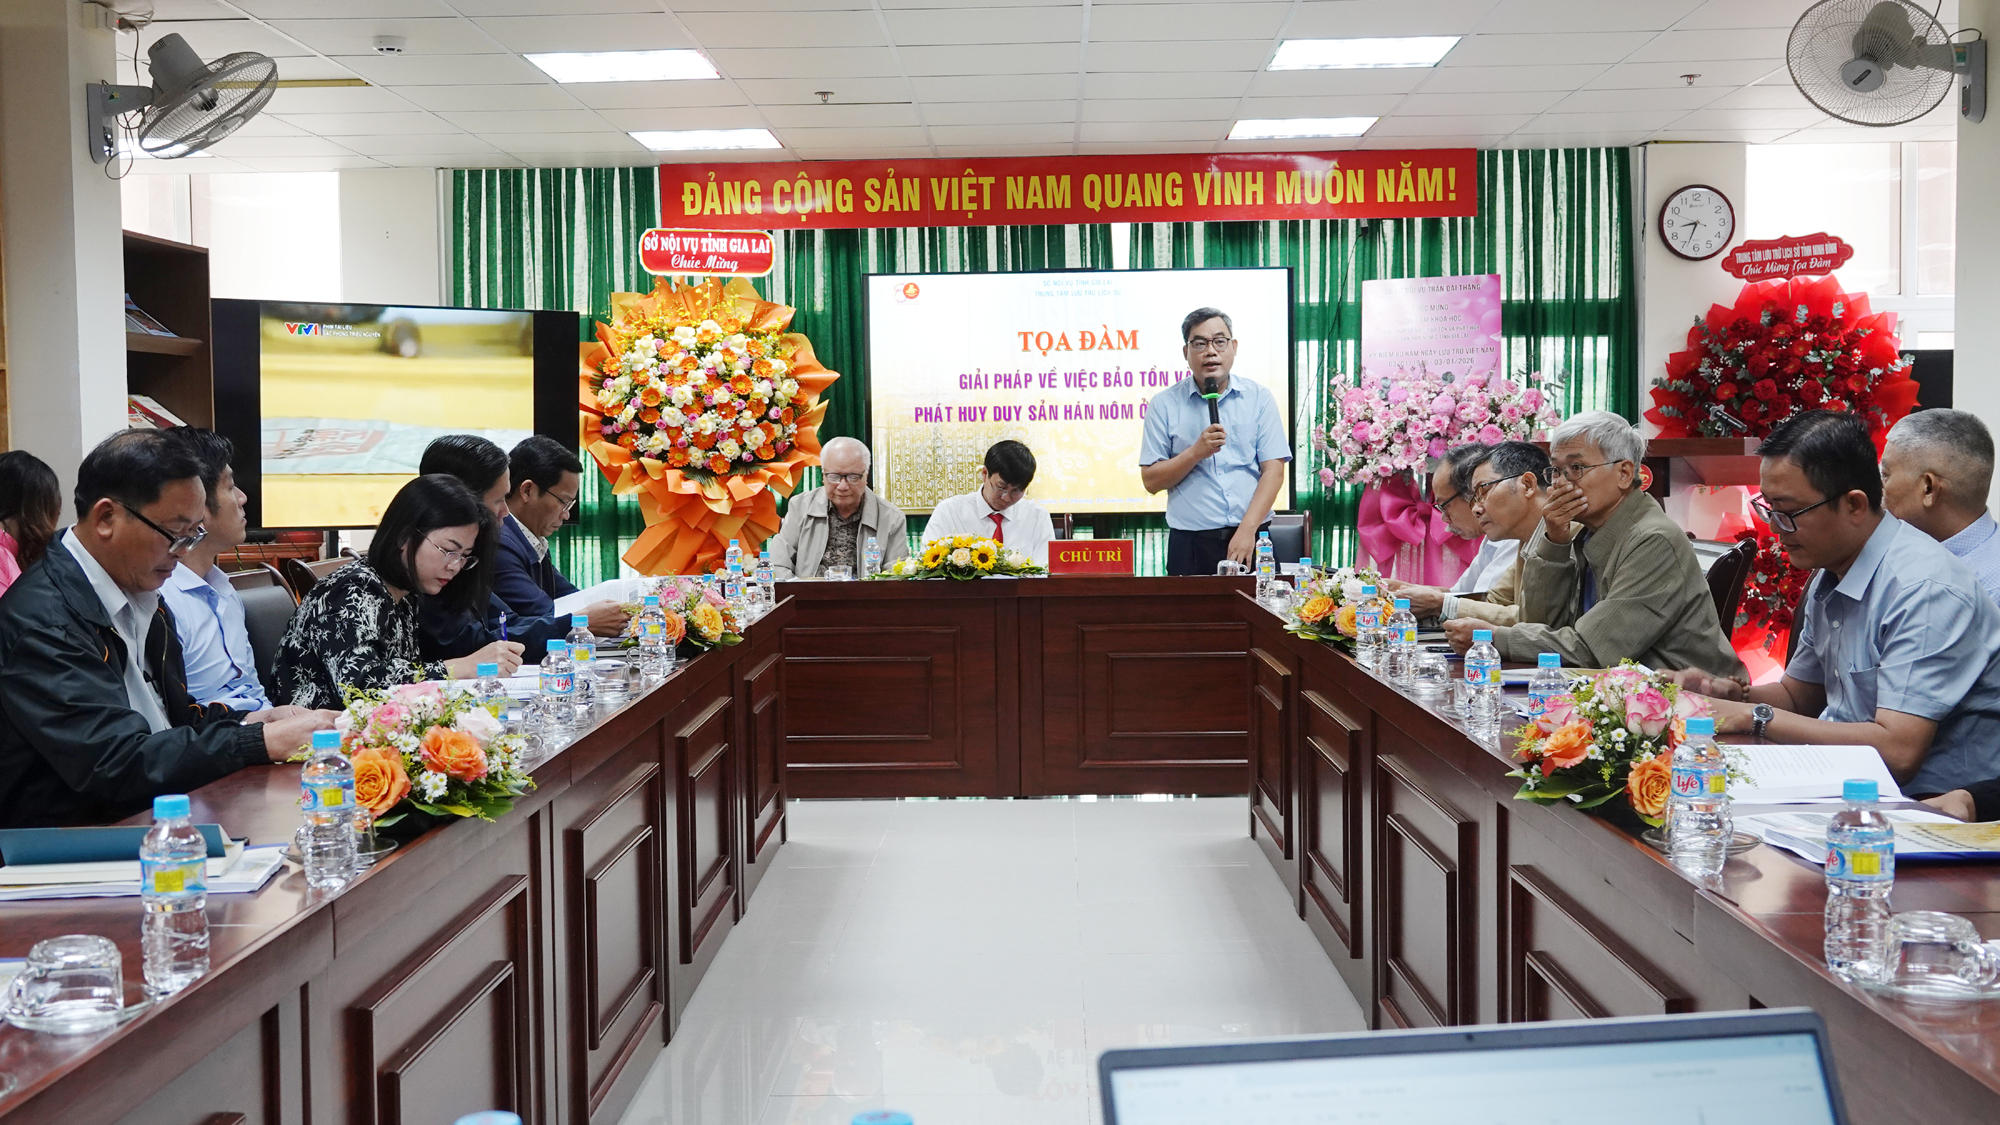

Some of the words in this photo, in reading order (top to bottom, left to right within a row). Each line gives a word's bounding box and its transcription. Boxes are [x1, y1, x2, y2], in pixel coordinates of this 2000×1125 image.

[681, 171, 762, 216] ĐẢNG
[773, 172, 853, 221] CỘNG
[864, 168, 920, 212] SẢN
[930, 168, 995, 218] VIỆT
[1007, 175, 1071, 210] NAM
[1083, 172, 1183, 212] QUANG
[1193, 172, 1264, 206] VINH
[1276, 162, 1365, 205] MUÔN
[1376, 161, 1457, 203] NĂM!
[1692, 193, 1701, 201] 12
[1671, 206, 1680, 215] 10
[1715, 205, 1722, 214] 2
[1667, 219, 1674, 228] 9
[1719, 218, 1726, 226] 3
[1672, 232, 1678, 240] 8
[1715, 231, 1721, 239] 4
[644, 231, 659, 251] SỞ
[660, 233, 680, 254] NỘI
[682, 237, 698, 254] VỤ
[701, 232, 728, 253] TỈNH
[729, 238, 750, 253] GIA
[751, 238, 770, 254] LAI
[1680, 241, 1687, 249] 7
[1693, 244, 1700, 252] 6
[1706, 240, 1712, 248] 5
[1736, 252, 1752, 264] TRUNG
[1782, 247, 1793, 261] LỊCH
[671, 254, 701, 269] Chúc
[702, 255, 739, 272] Mừng
[1742, 264, 1762, 275] Chúc
[1792, 259, 1807, 272] Tọa
[1809, 257, 1832, 268] Đàm
[285, 322, 318, 336] VTV1
[1018, 331, 1073, 357] TỌA
[1078, 324, 1140, 350] ĐÀM
[959, 368, 988, 390] GIẢI
[994, 369, 1032, 389] PHÁP
[1038, 366, 1057, 388] VỀ
[1064, 369, 1098, 392] VIỆC
[1104, 366, 1133, 387] BẢO
[1139, 365, 1169, 387] TỒN
[915, 403, 953, 423] PHÁT
[958, 406, 987, 422] HUY
[994, 405, 1022, 422] DUY
[1028, 399, 1058, 421] SẢN
[1064, 401, 1094, 420] HÁN
[1100, 401, 1133, 420] NÔM
[1060, 548, 1092, 562] CHỦ
[1096, 547, 1122, 561] TRÌ
